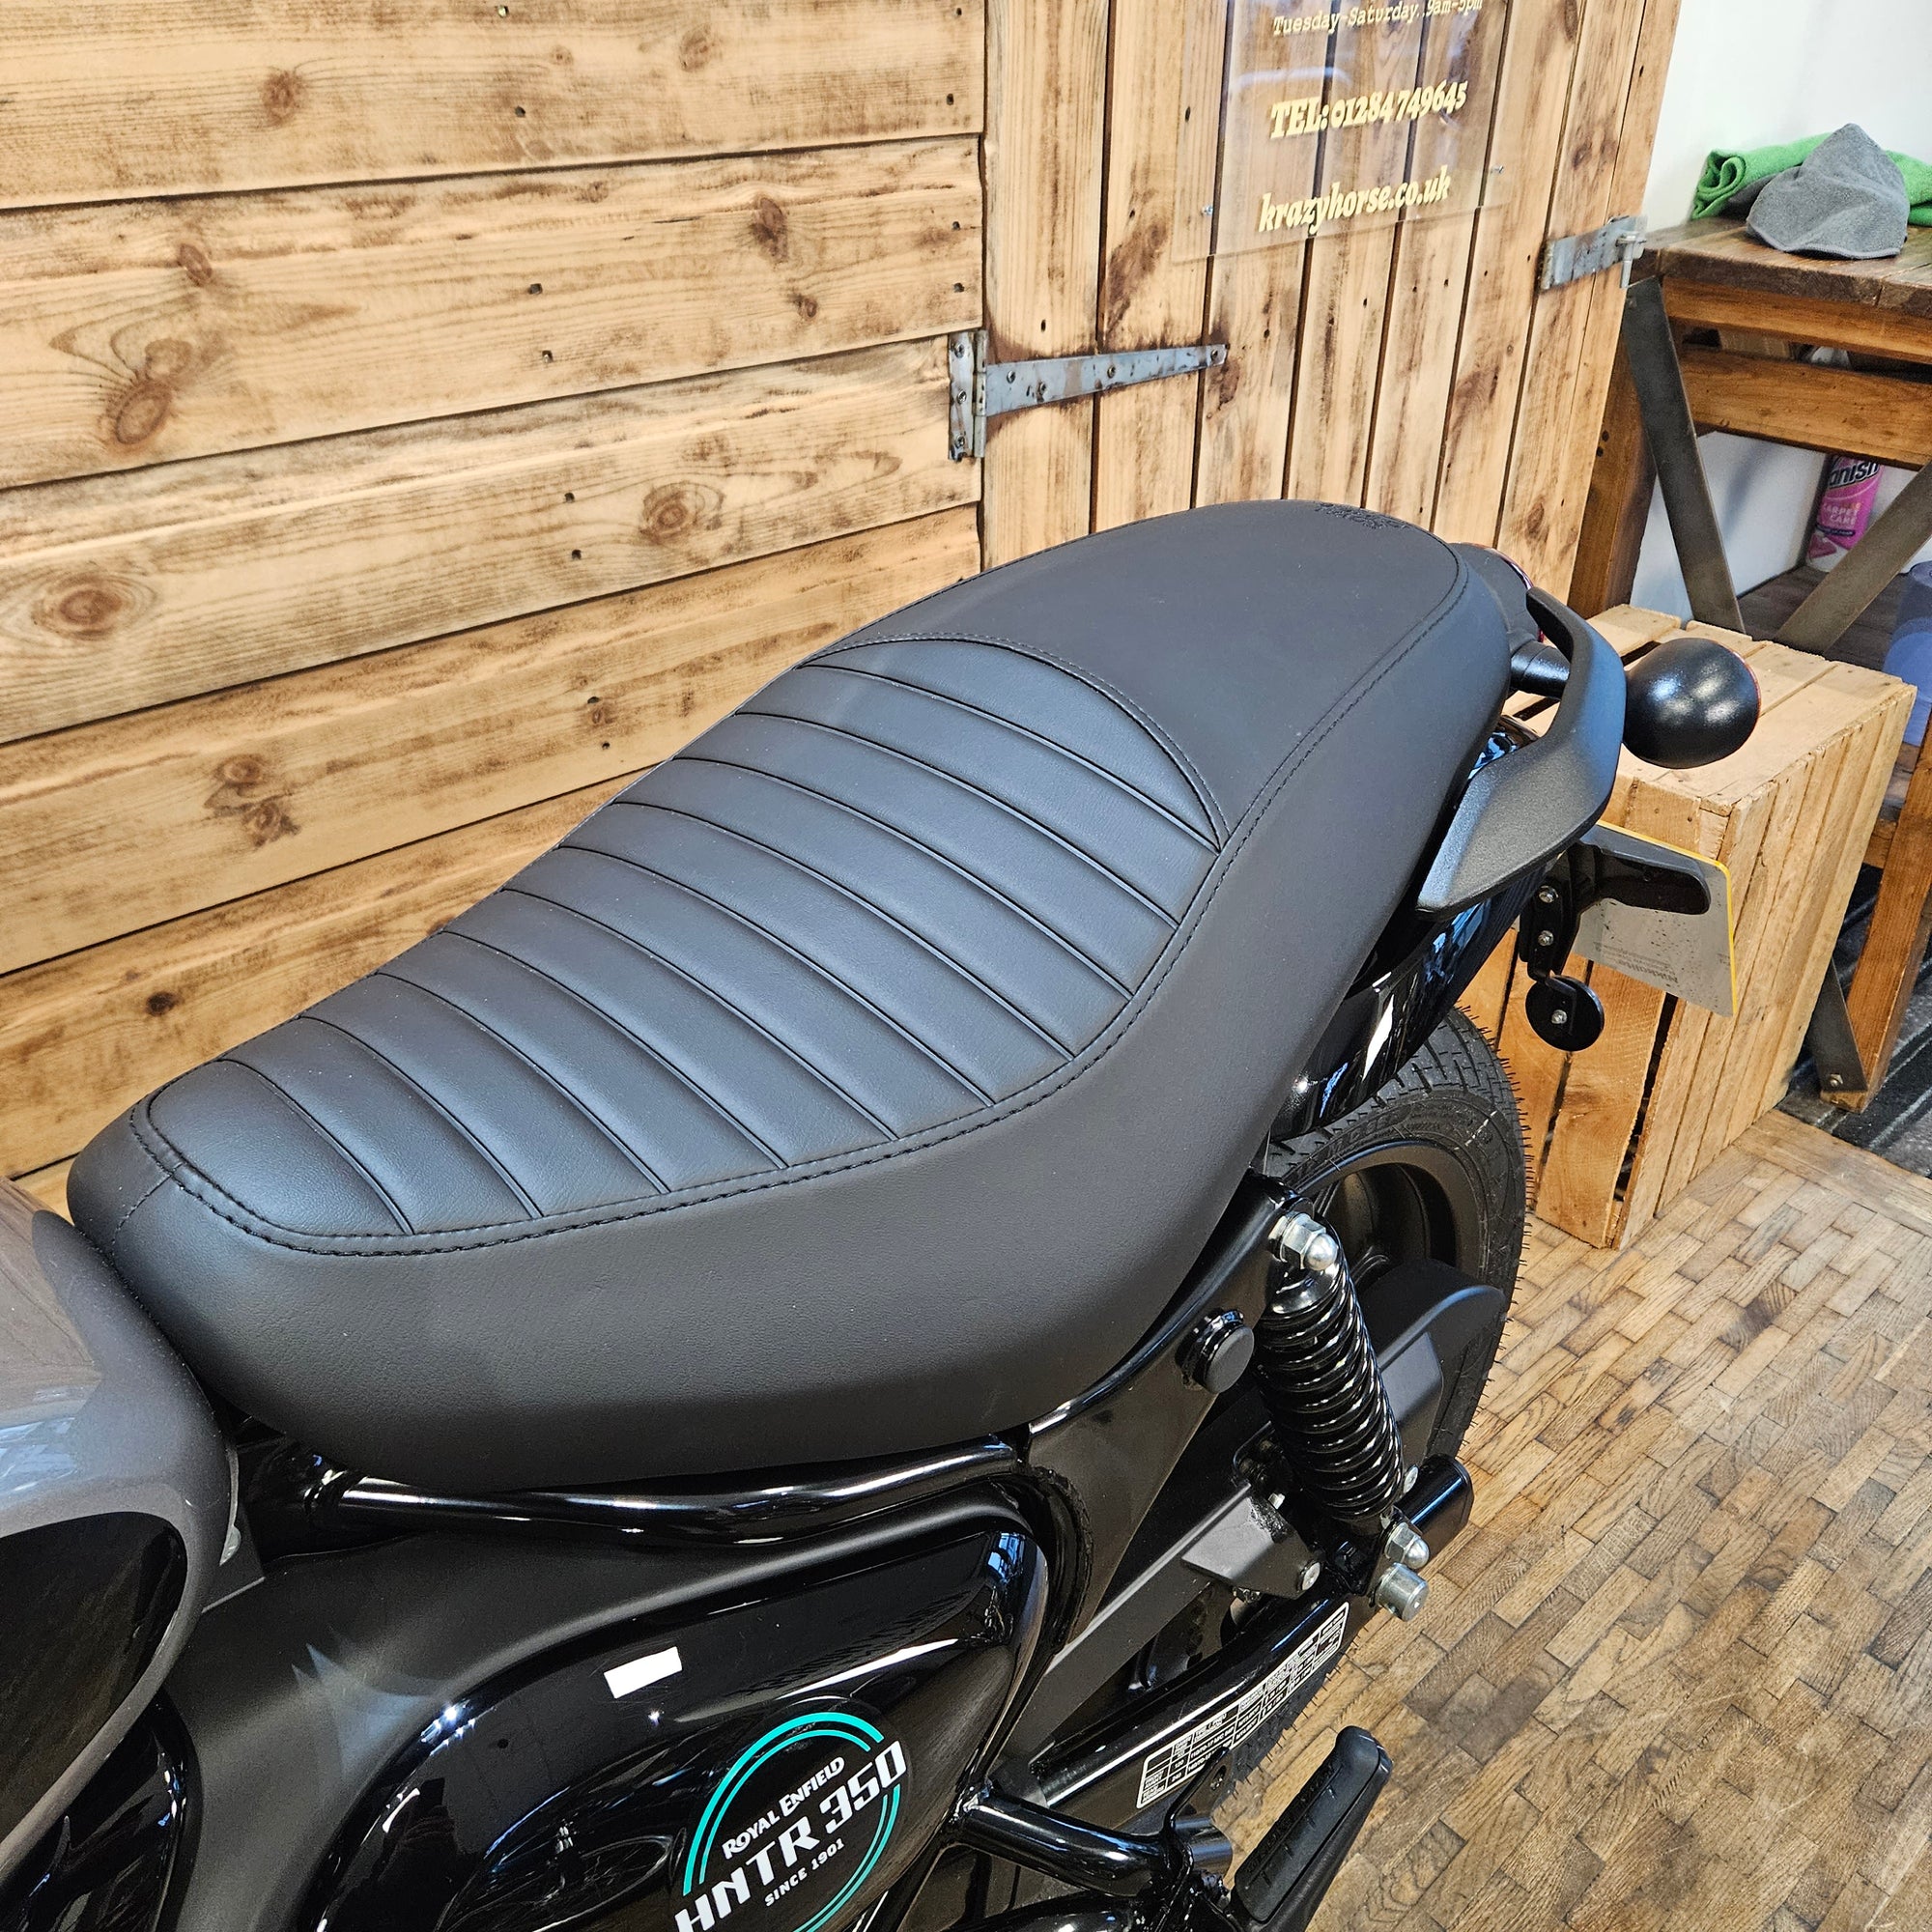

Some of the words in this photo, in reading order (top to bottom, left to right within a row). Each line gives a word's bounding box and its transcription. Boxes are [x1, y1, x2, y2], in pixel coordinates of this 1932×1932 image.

[1258, 165, 1451, 235] krazyhorse.co.uk
[674, 1816, 820, 1932] HNTR
[818, 1740, 907, 1834] 350
[722, 1809, 781, 1860] ROYAL
[778, 1756, 845, 1817] ENFIELD
[764, 1866, 808, 1907] SINCE
[810, 1837, 845, 1871] 1901
